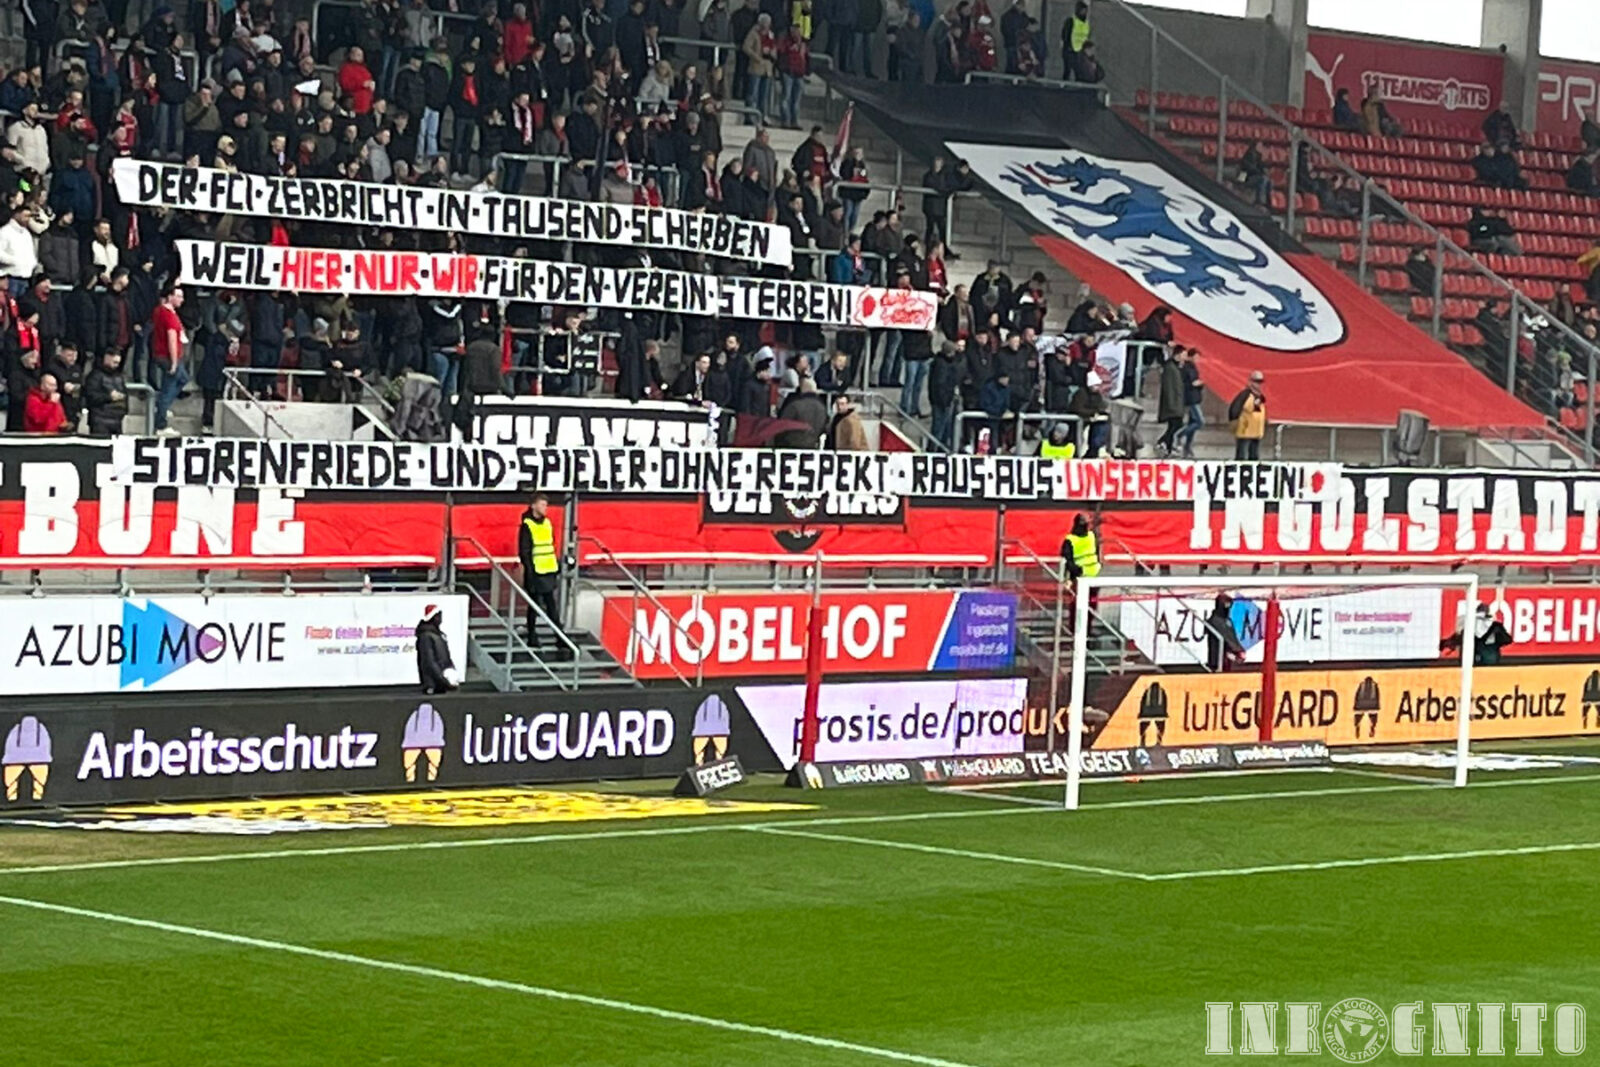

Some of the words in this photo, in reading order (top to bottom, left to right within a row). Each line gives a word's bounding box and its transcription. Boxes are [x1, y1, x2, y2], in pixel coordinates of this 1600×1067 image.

[1538, 73, 1600, 123] PR
[139, 164, 199, 204] DER
[210, 172, 254, 211] FCI
[265, 176, 422, 226] ZERBRICHT
[438, 192, 470, 228] IN
[483, 198, 622, 241] TAUSEND
[631, 210, 770, 258] SCHERBEN
[192, 243, 271, 286] WEIL
[280, 249, 343, 291] HIER
[354, 253, 421, 292] NUR
[432, 255, 479, 295] WIR
[482, 259, 535, 298] FÜR
[546, 267, 604, 304] DEN
[612, 271, 712, 312] VEREIN
[718, 278, 852, 324] STERBEN!
[133, 437, 413, 487] STÖRENFRIEDE
[430, 444, 507, 488] UND
[516, 448, 647, 491] SPIELER
[660, 448, 743, 490] OHNE
[755, 451, 890, 492] RESPEKT
[911, 453, 986, 497] RAUS
[999, 456, 1053, 499] AUS
[1065, 461, 1194, 499] UNSEREM
[1203, 462, 1304, 499] VEREIN!
[15, 622, 138, 668] AZUBI
[157, 621, 287, 665] MOVIE
[1156, 608, 1212, 643] AZU
[1395, 685, 1567, 723] Arbesschutz
[77, 723, 378, 780] Arbeitsschutz
[462, 709, 675, 765] luitGUARD
